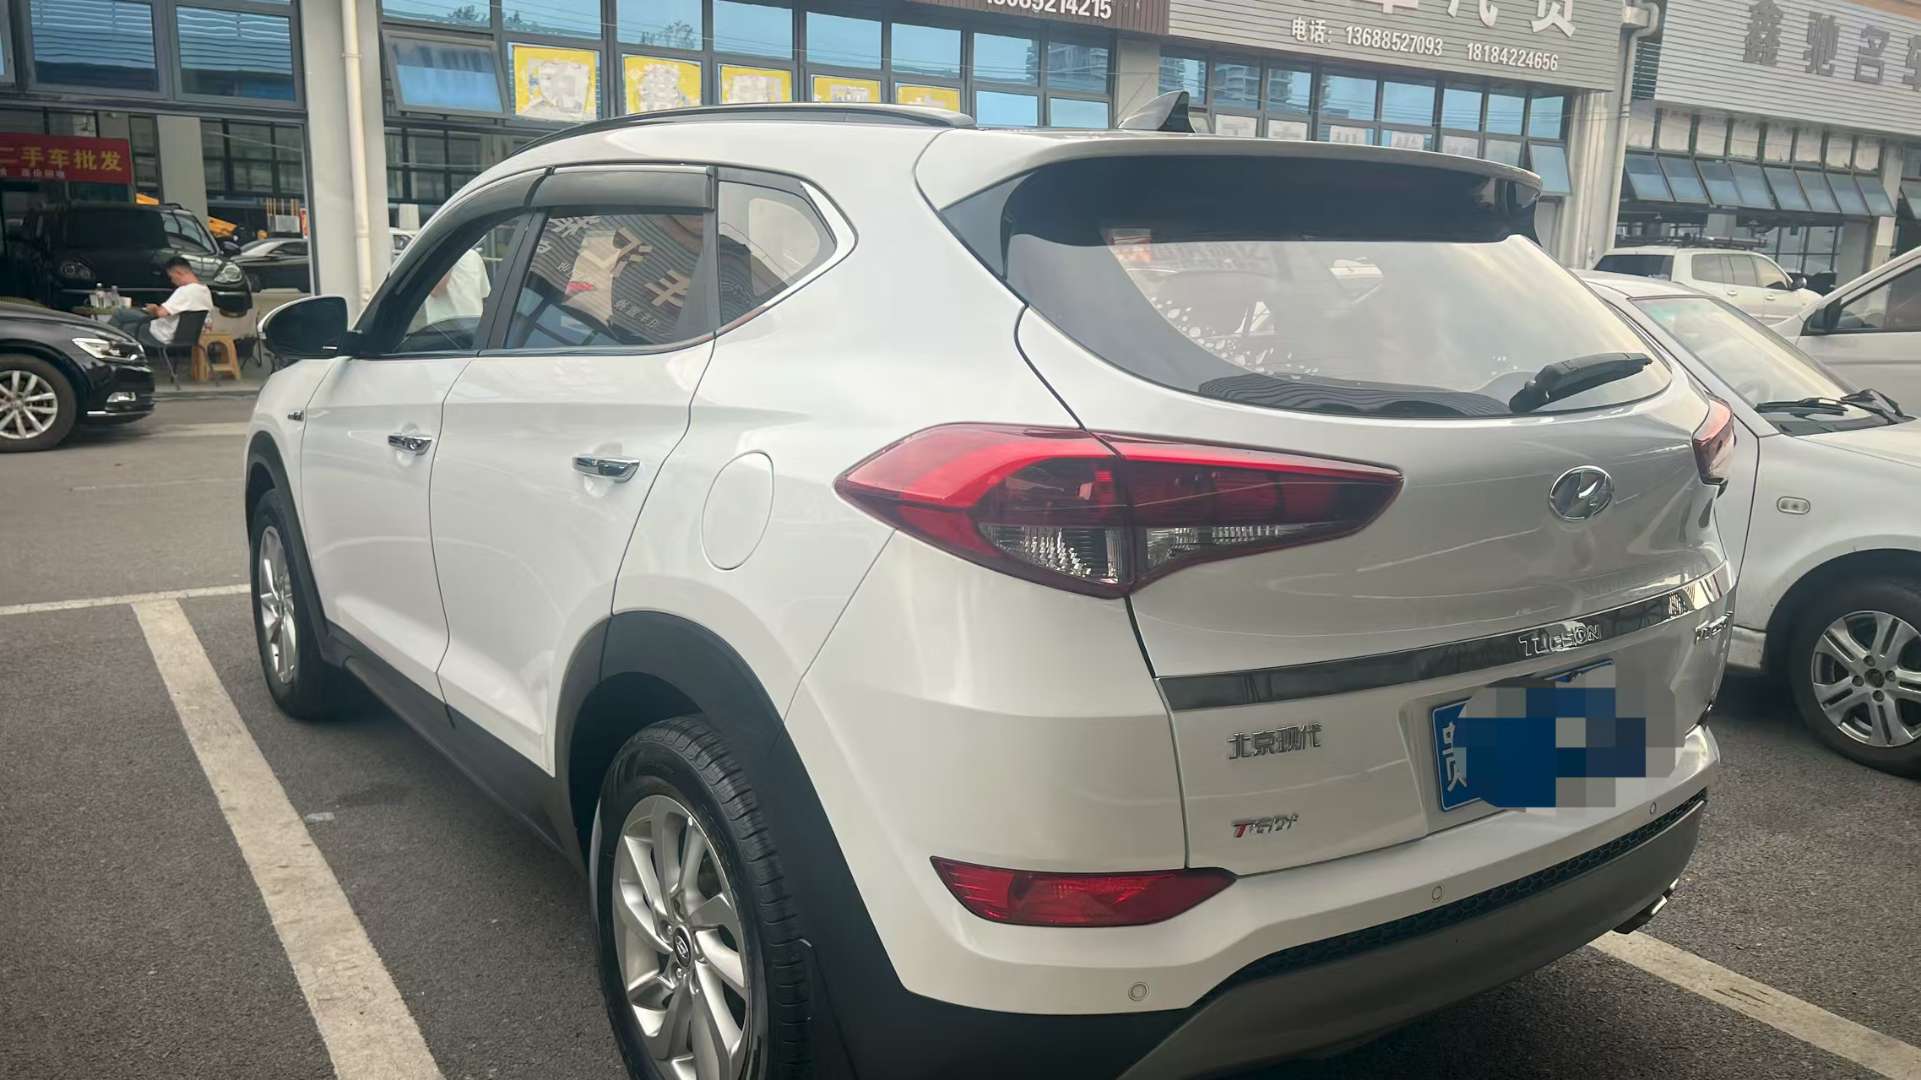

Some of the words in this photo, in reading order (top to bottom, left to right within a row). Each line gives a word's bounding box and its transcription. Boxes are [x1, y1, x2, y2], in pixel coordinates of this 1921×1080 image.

[987, 0, 1112, 19] 214215
[1346, 26, 1444, 56] 13688527093
[1467, 43, 1559, 71] 18184224656
[0, 146, 123, 171] 二手车批发
[1228, 722, 1322, 760] 北京现代
